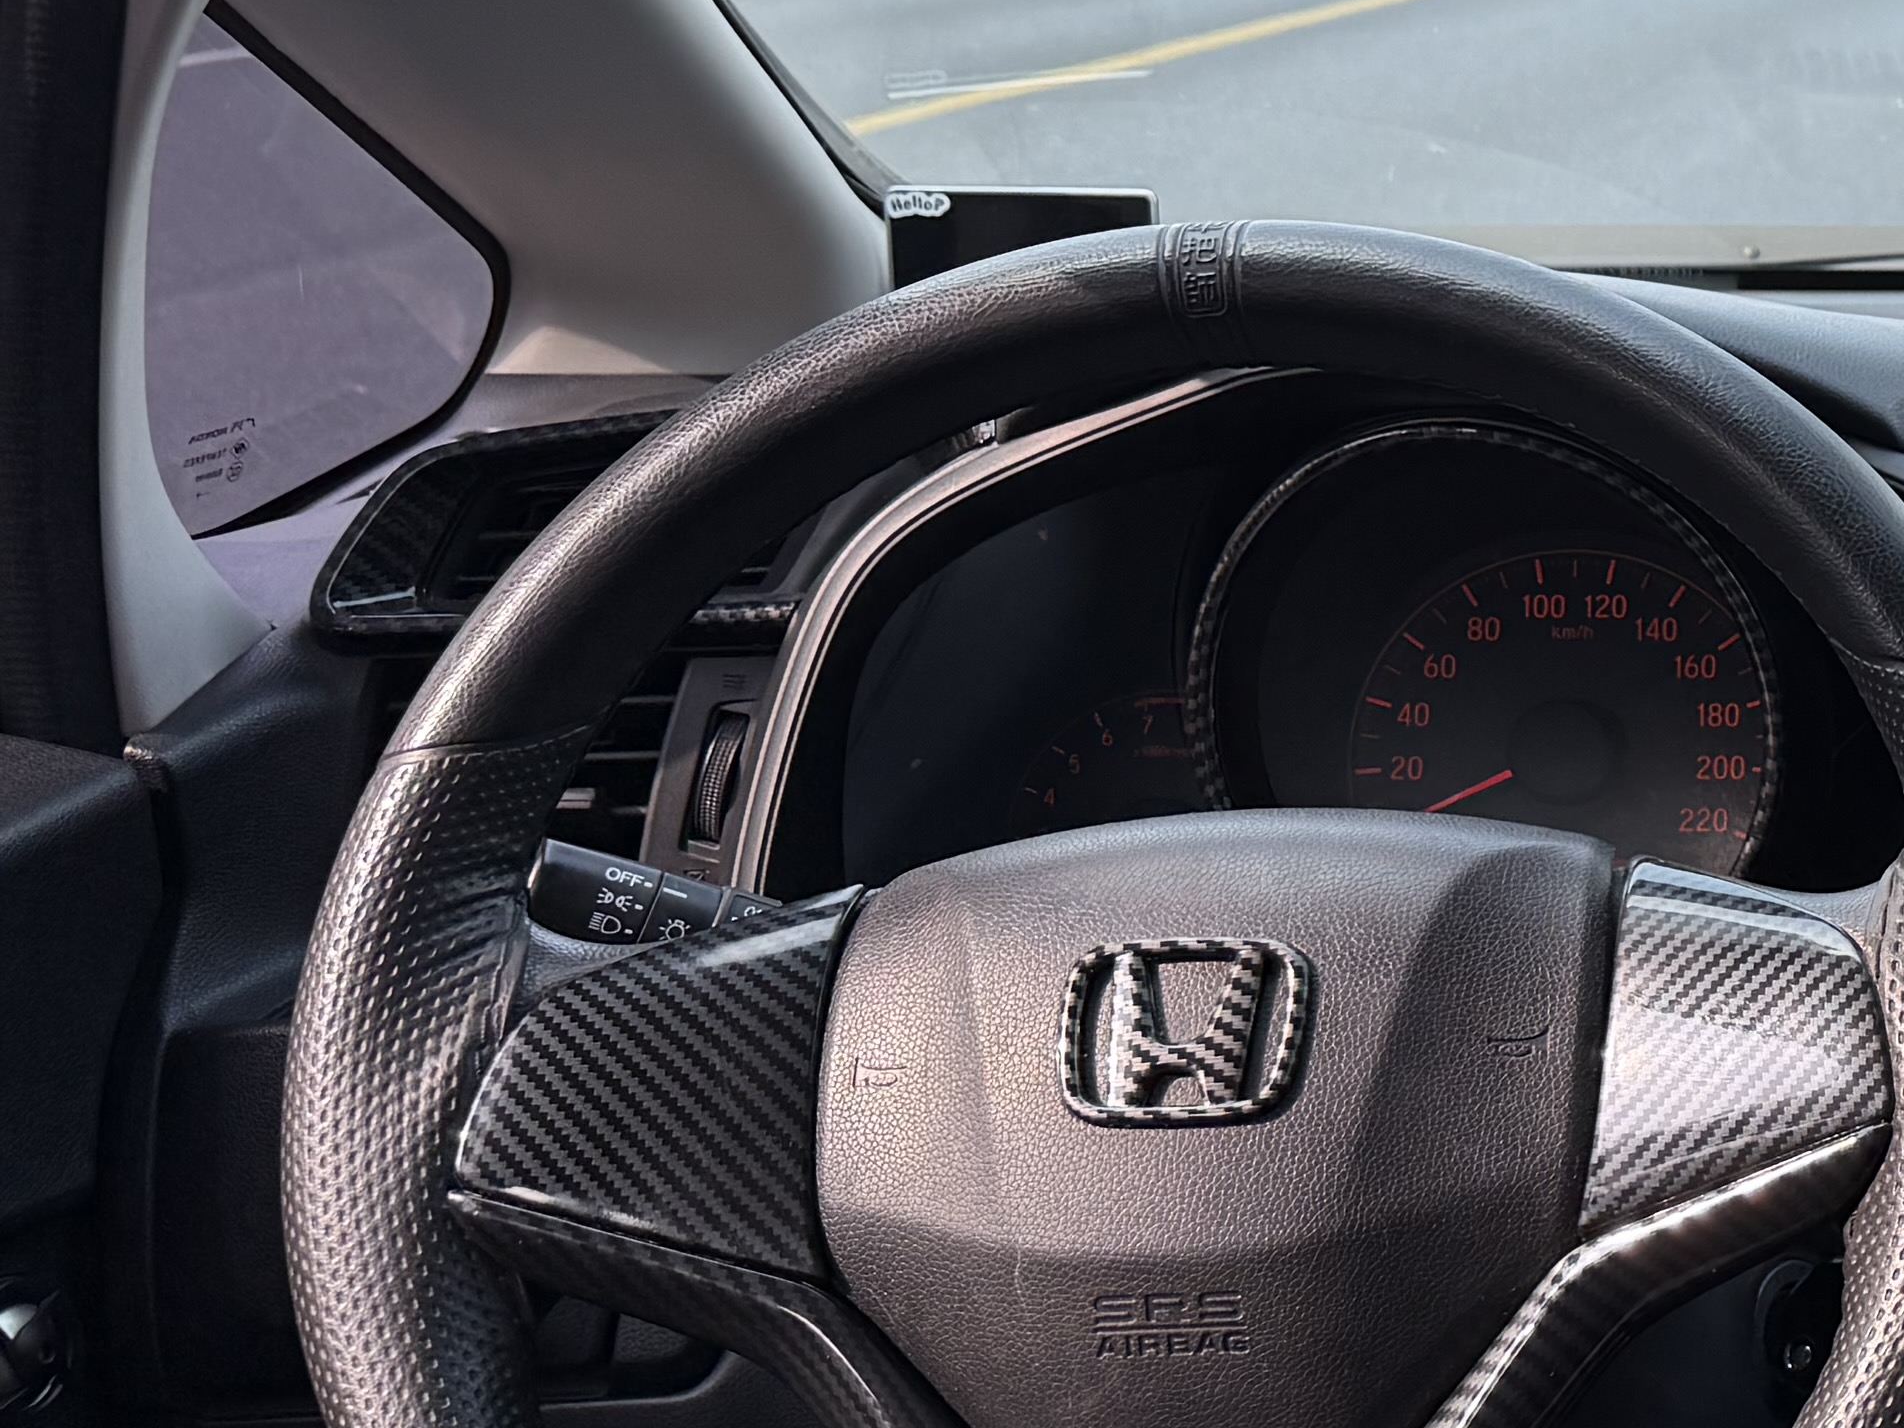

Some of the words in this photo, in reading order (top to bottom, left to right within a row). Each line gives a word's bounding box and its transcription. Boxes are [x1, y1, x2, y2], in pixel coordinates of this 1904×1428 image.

[1522, 595, 1565, 619] 100
[1584, 595, 1626, 619] 120
[1467, 616, 1500, 641] 80
[1634, 617, 1677, 641] 140
[1423, 654, 1455, 679] 60
[1673, 655, 1717, 679] 160
[1397, 702, 1430, 727] 40
[1696, 703, 1739, 727] 180
[1390, 755, 1423, 780] 20
[1696, 755, 1745, 780] 200
[1044, 788, 1055, 807] 4
[1678, 808, 1728, 832] 220
[605, 867, 643, 886] OFF
[1094, 1291, 1243, 1323] SRS
[1096, 1335, 1250, 1357] AIRBAG
